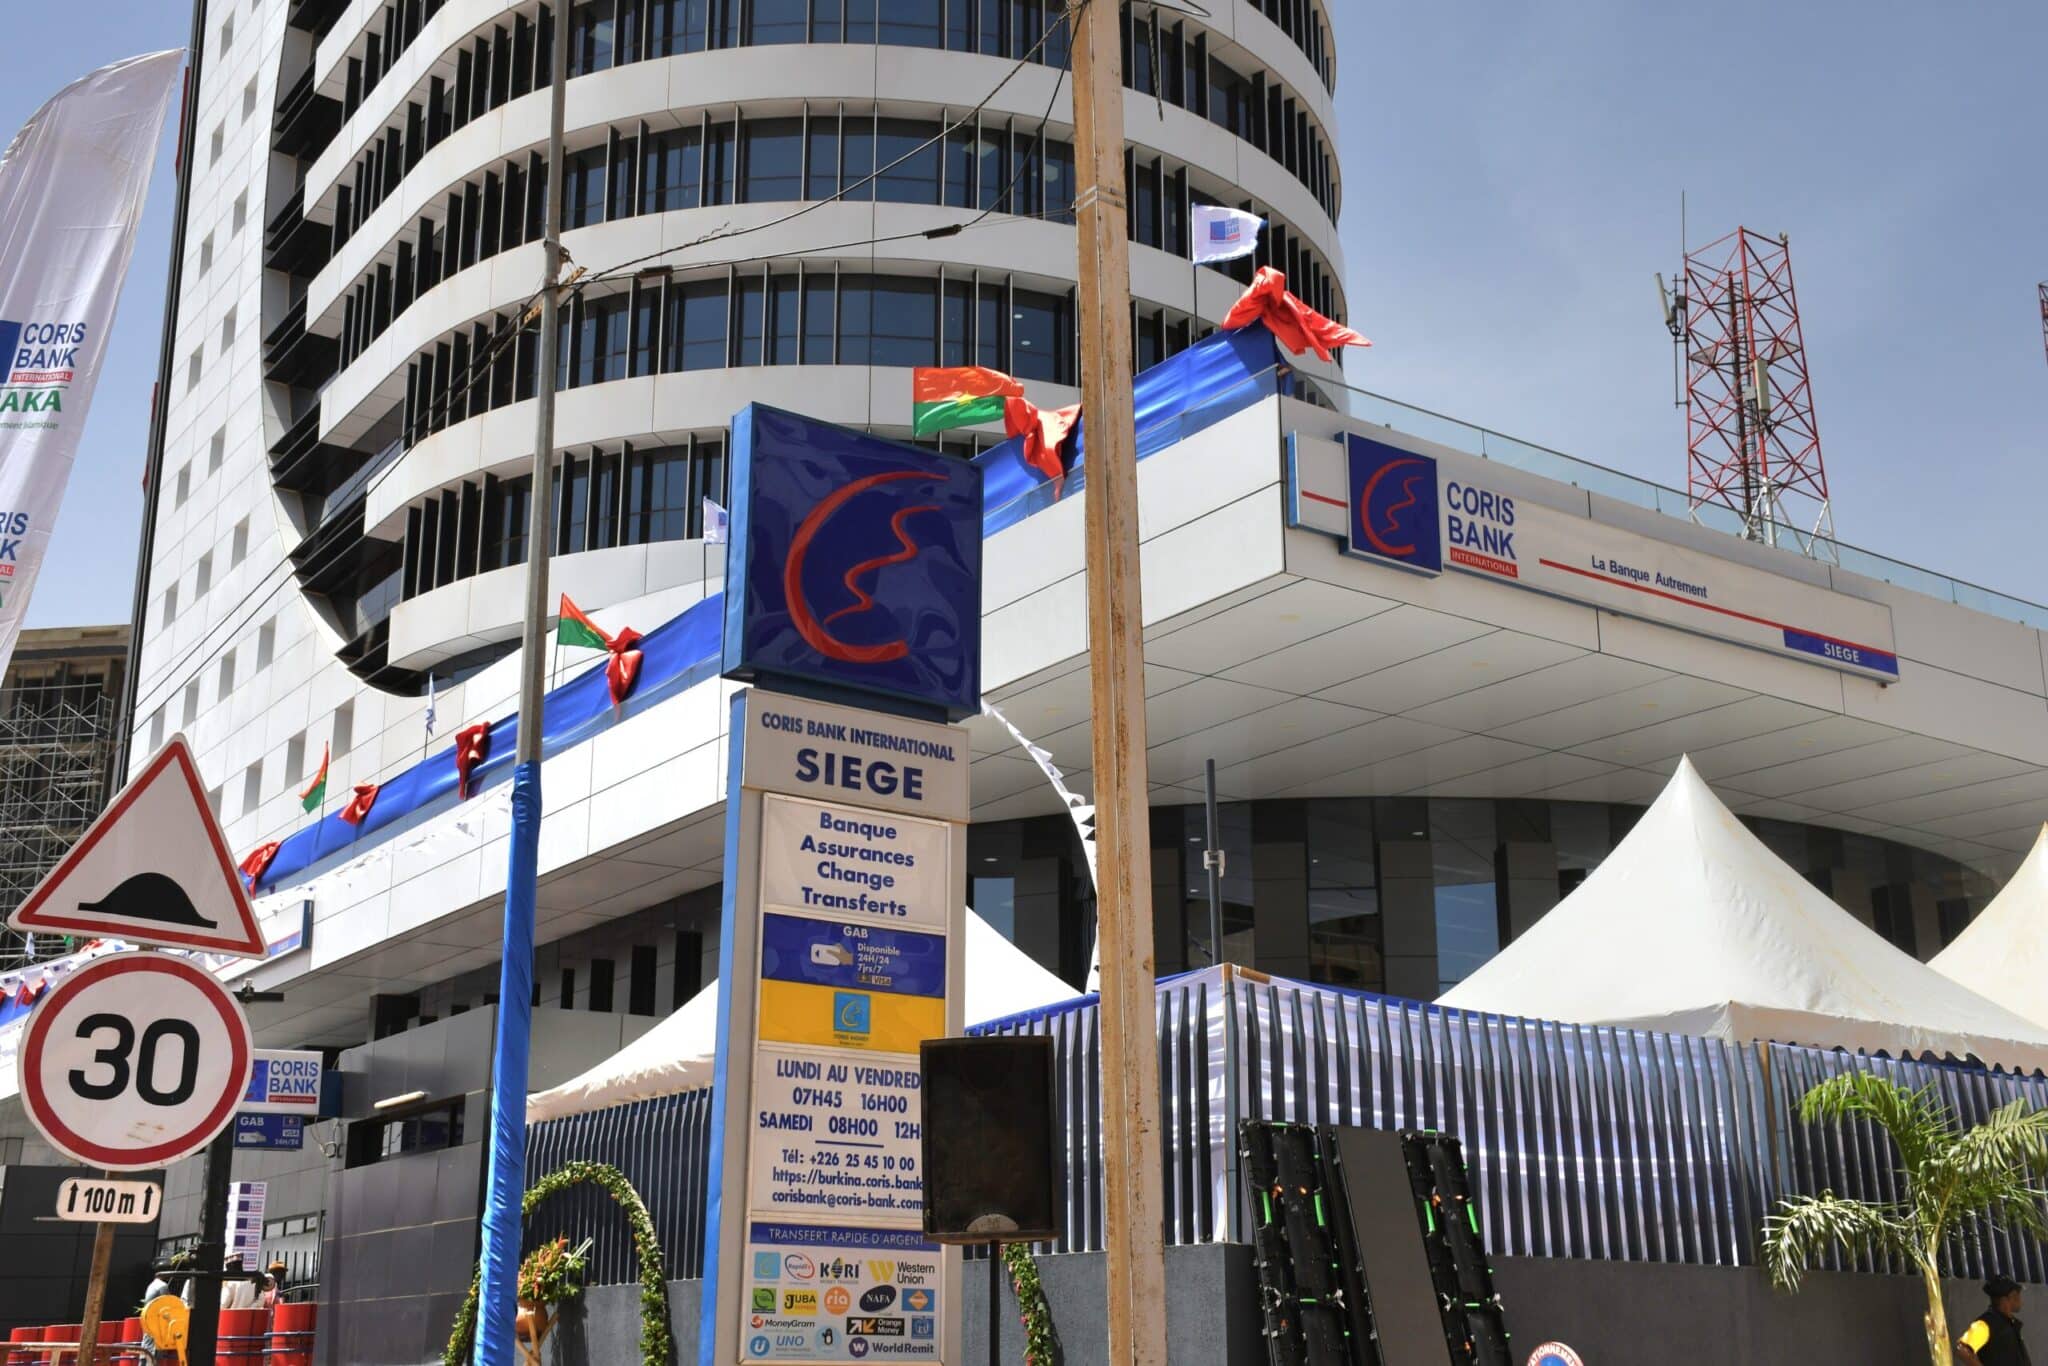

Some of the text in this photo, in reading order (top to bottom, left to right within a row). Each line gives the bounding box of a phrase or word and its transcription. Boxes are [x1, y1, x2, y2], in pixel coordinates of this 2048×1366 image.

[24, 323, 86, 344] CORIS
[15, 348, 79, 368] BANK
[1447, 481, 1514, 526] CORIS
[1448, 515, 1516, 560] BANK
[1451, 551, 1516, 575] INTERNATIONAL
[1592, 555, 1708, 598] La Banque Autrement
[1824, 642, 1860, 663] SIEGE
[761, 712, 955, 761] CORIS BANK INTERNATIONAL
[795, 748, 923, 800] SIEGE
[820, 812, 897, 841] Banque
[800, 835, 915, 867] Assurances
[817, 861, 895, 890] Change
[802, 887, 907, 916] Transferts
[843, 926, 868, 938] GAB
[857, 943, 900, 956] Disponible
[857, 953, 890, 965] 24H/24
[69, 1013, 200, 1106] 30
[270, 1061, 319, 1077] CORIS
[777, 1059, 921, 1089] LUNDI AU VENDRED
[270, 1078, 316, 1094] BANK
[793, 1087, 907, 1113] 07H45 16H00
[240, 1116, 264, 1127] GAB
[759, 1111, 922, 1140] SAMEDI 08H00 12H
[782, 1149, 915, 1171] Tél: +226 25 45 10 00
[84, 1188, 135, 1214] 100 m
[772, 1189, 923, 1210] corisbank@coris-bank.com
[769, 1228, 924, 1246] TRANSFERT RAPIDE D'ARGENT
[897, 1261, 935, 1273] Western
[897, 1273, 924, 1284] Union
[784, 1294, 816, 1309] JUBA
[826, 1289, 848, 1305] ria
[765, 1319, 815, 1329] MoneyGram
[878, 1319, 902, 1327] Orange
[878, 1326, 900, 1335] Money
[776, 1335, 805, 1346] UNO
[872, 1342, 934, 1353] WorldRemit
